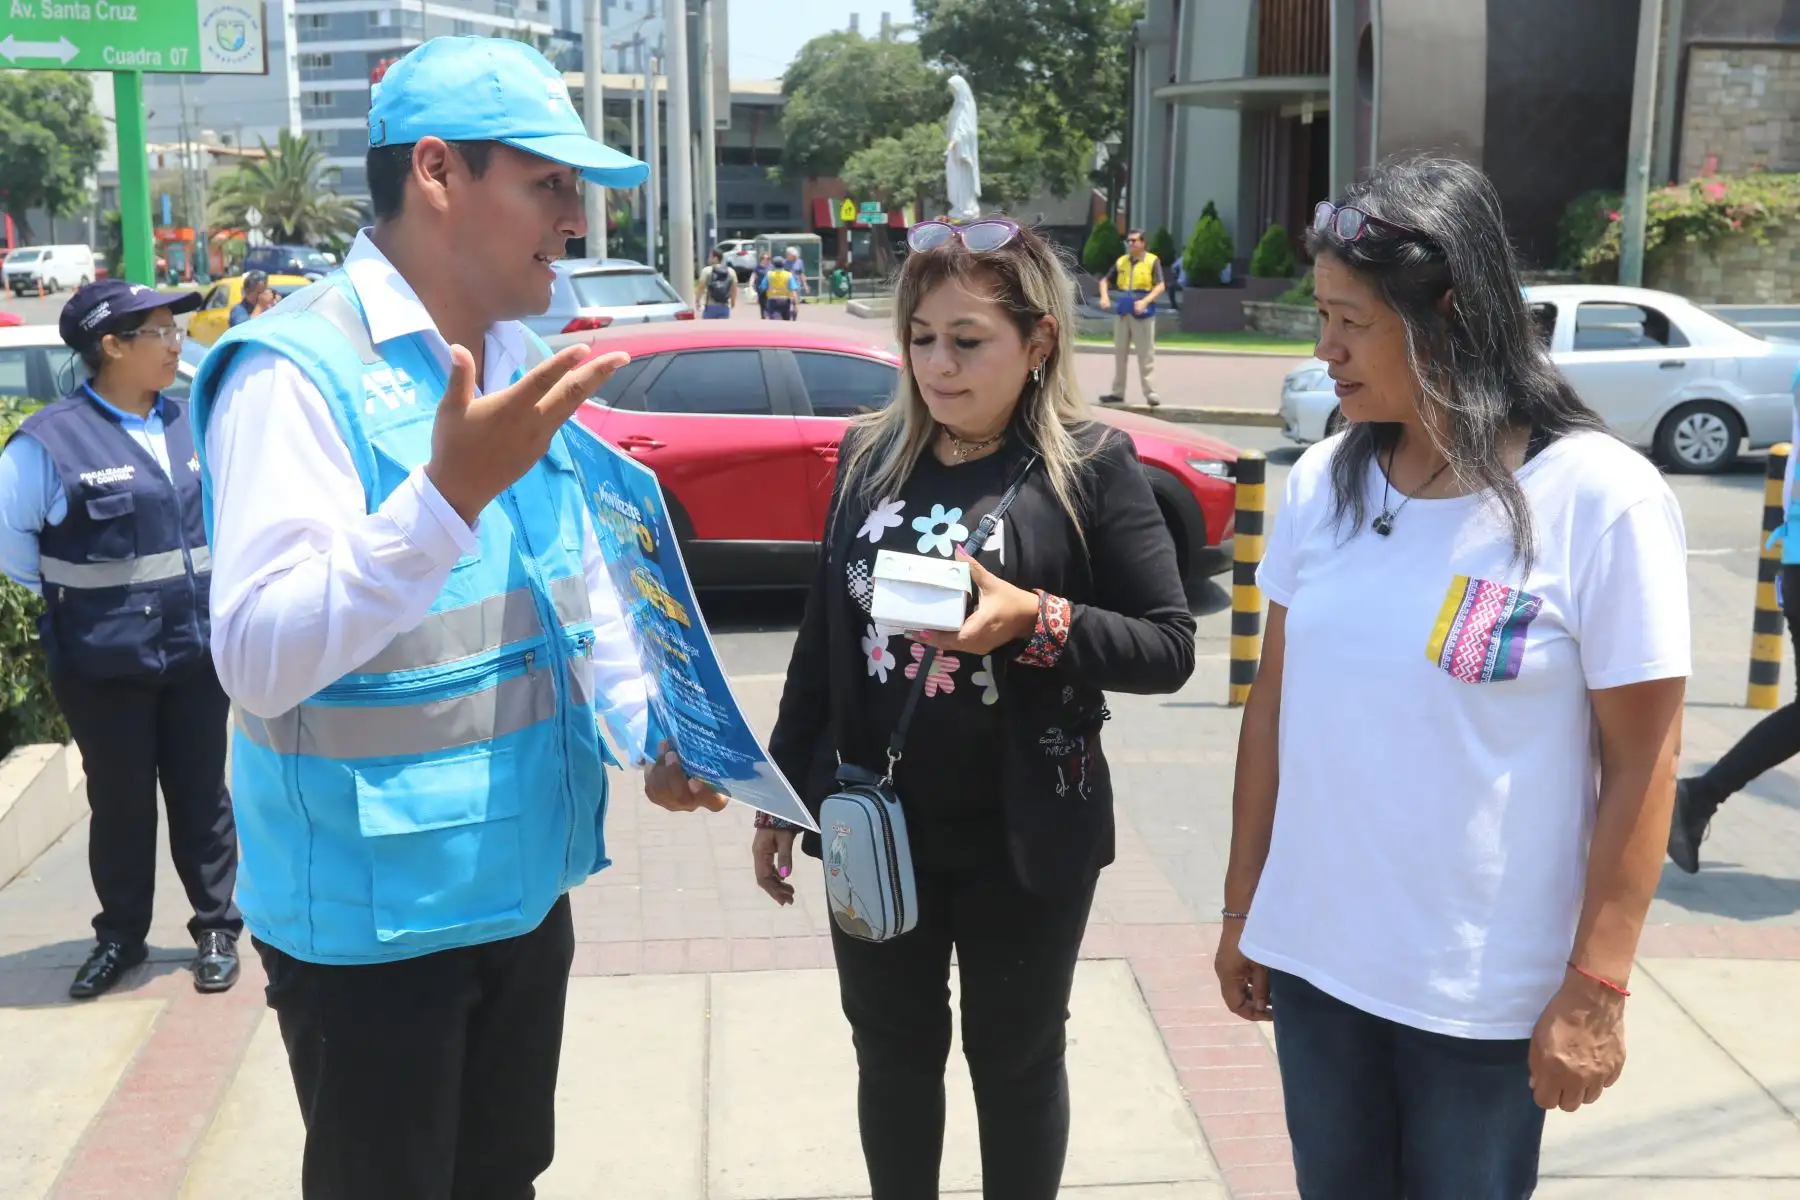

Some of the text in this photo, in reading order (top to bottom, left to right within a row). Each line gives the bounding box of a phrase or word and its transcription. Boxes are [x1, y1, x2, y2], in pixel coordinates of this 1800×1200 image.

[10, 0, 138, 21] Av. Santa Cruz
[103, 46, 162, 66] Cuadra
[170, 48, 189, 66] 07
